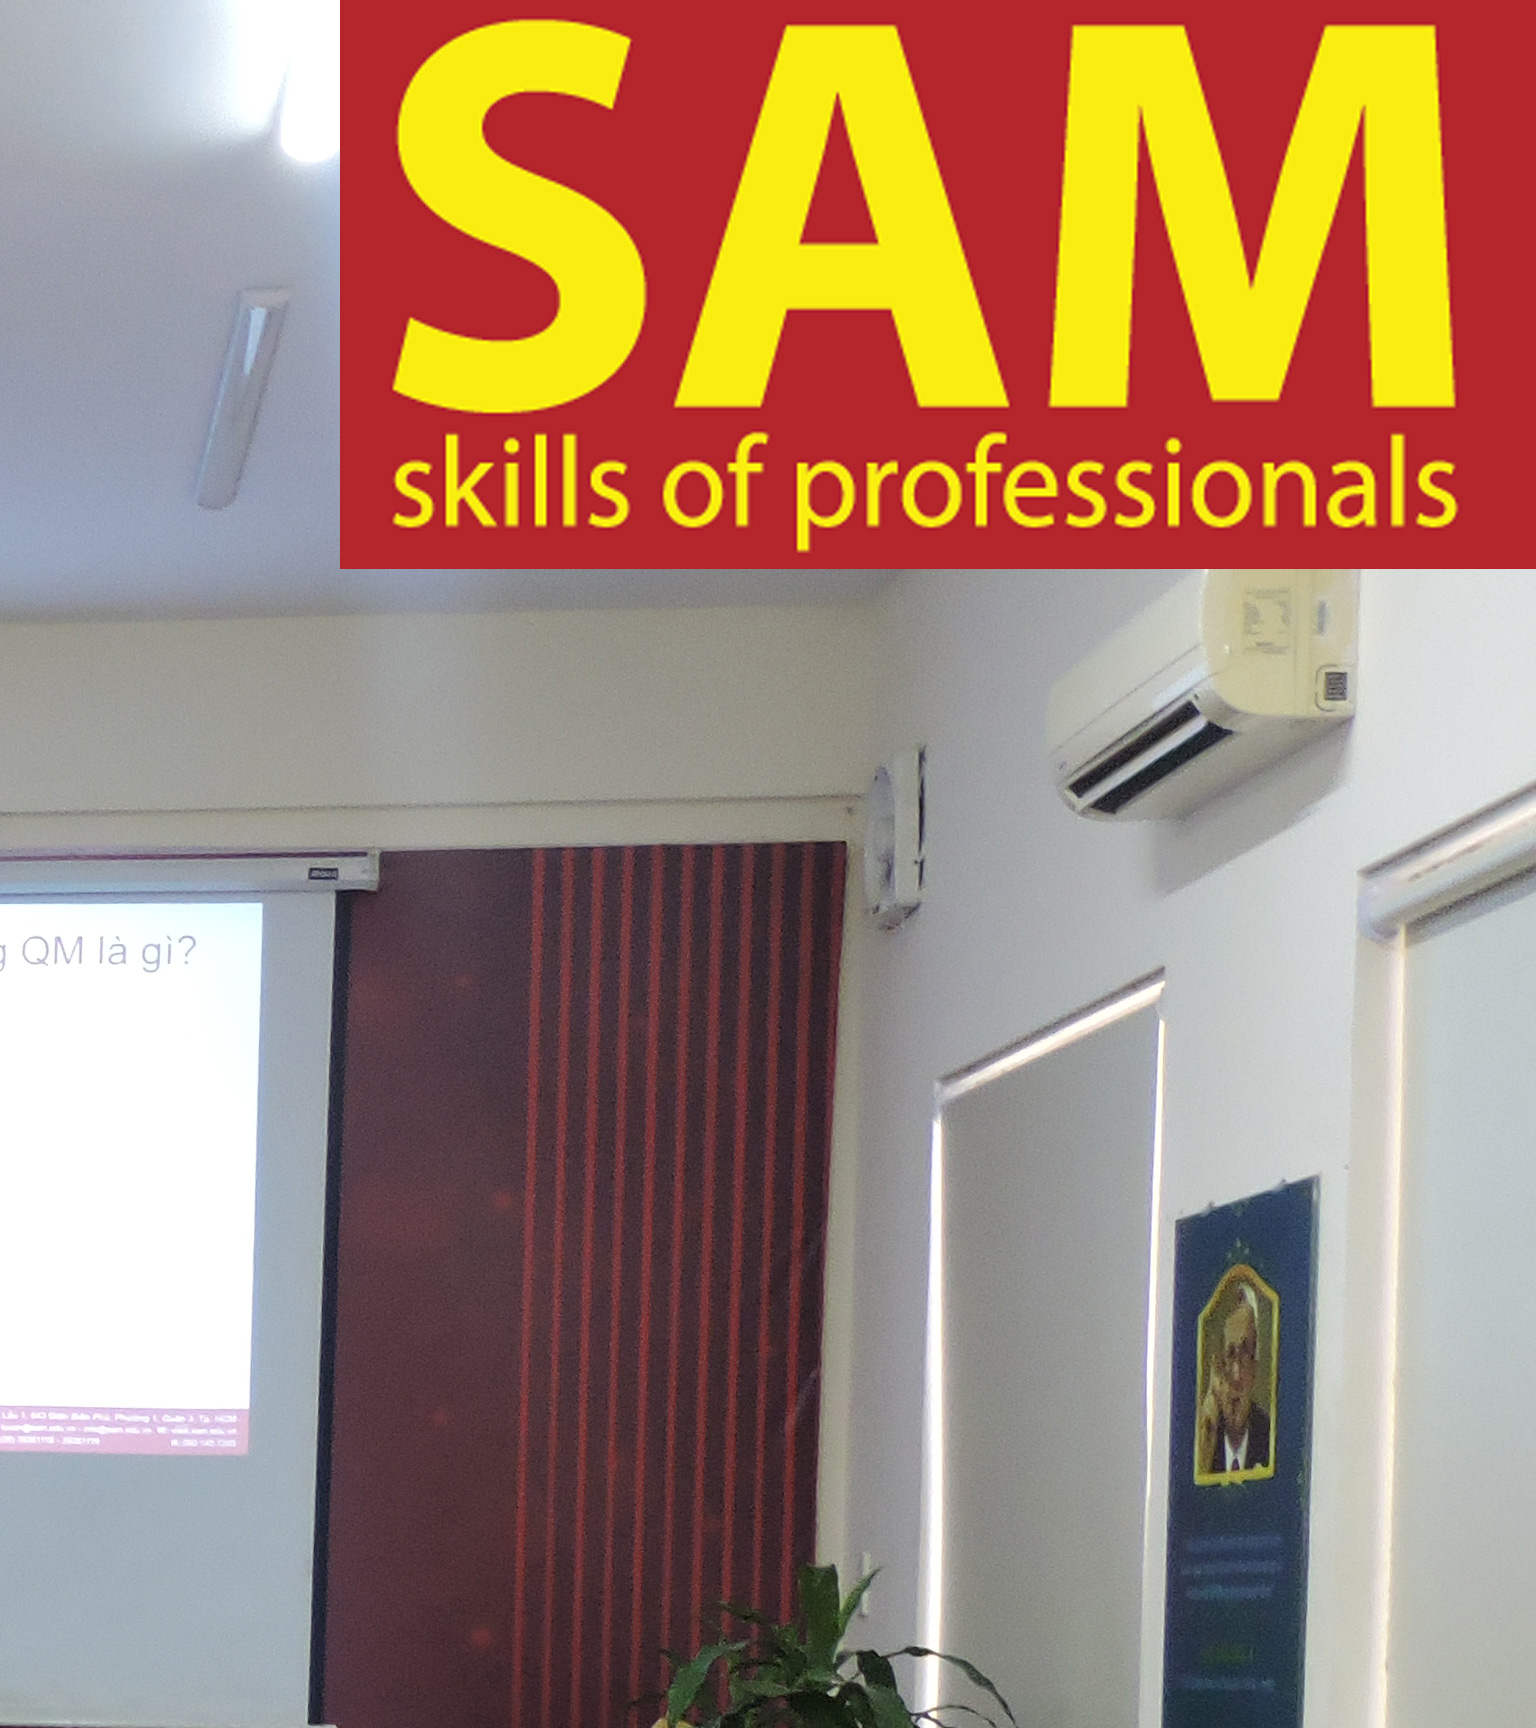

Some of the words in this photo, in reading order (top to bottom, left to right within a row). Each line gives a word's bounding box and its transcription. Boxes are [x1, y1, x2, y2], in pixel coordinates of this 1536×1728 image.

[21, 935, 84, 966] QM
[99, 935, 127, 965] là
[141, 935, 198, 973] gì?
